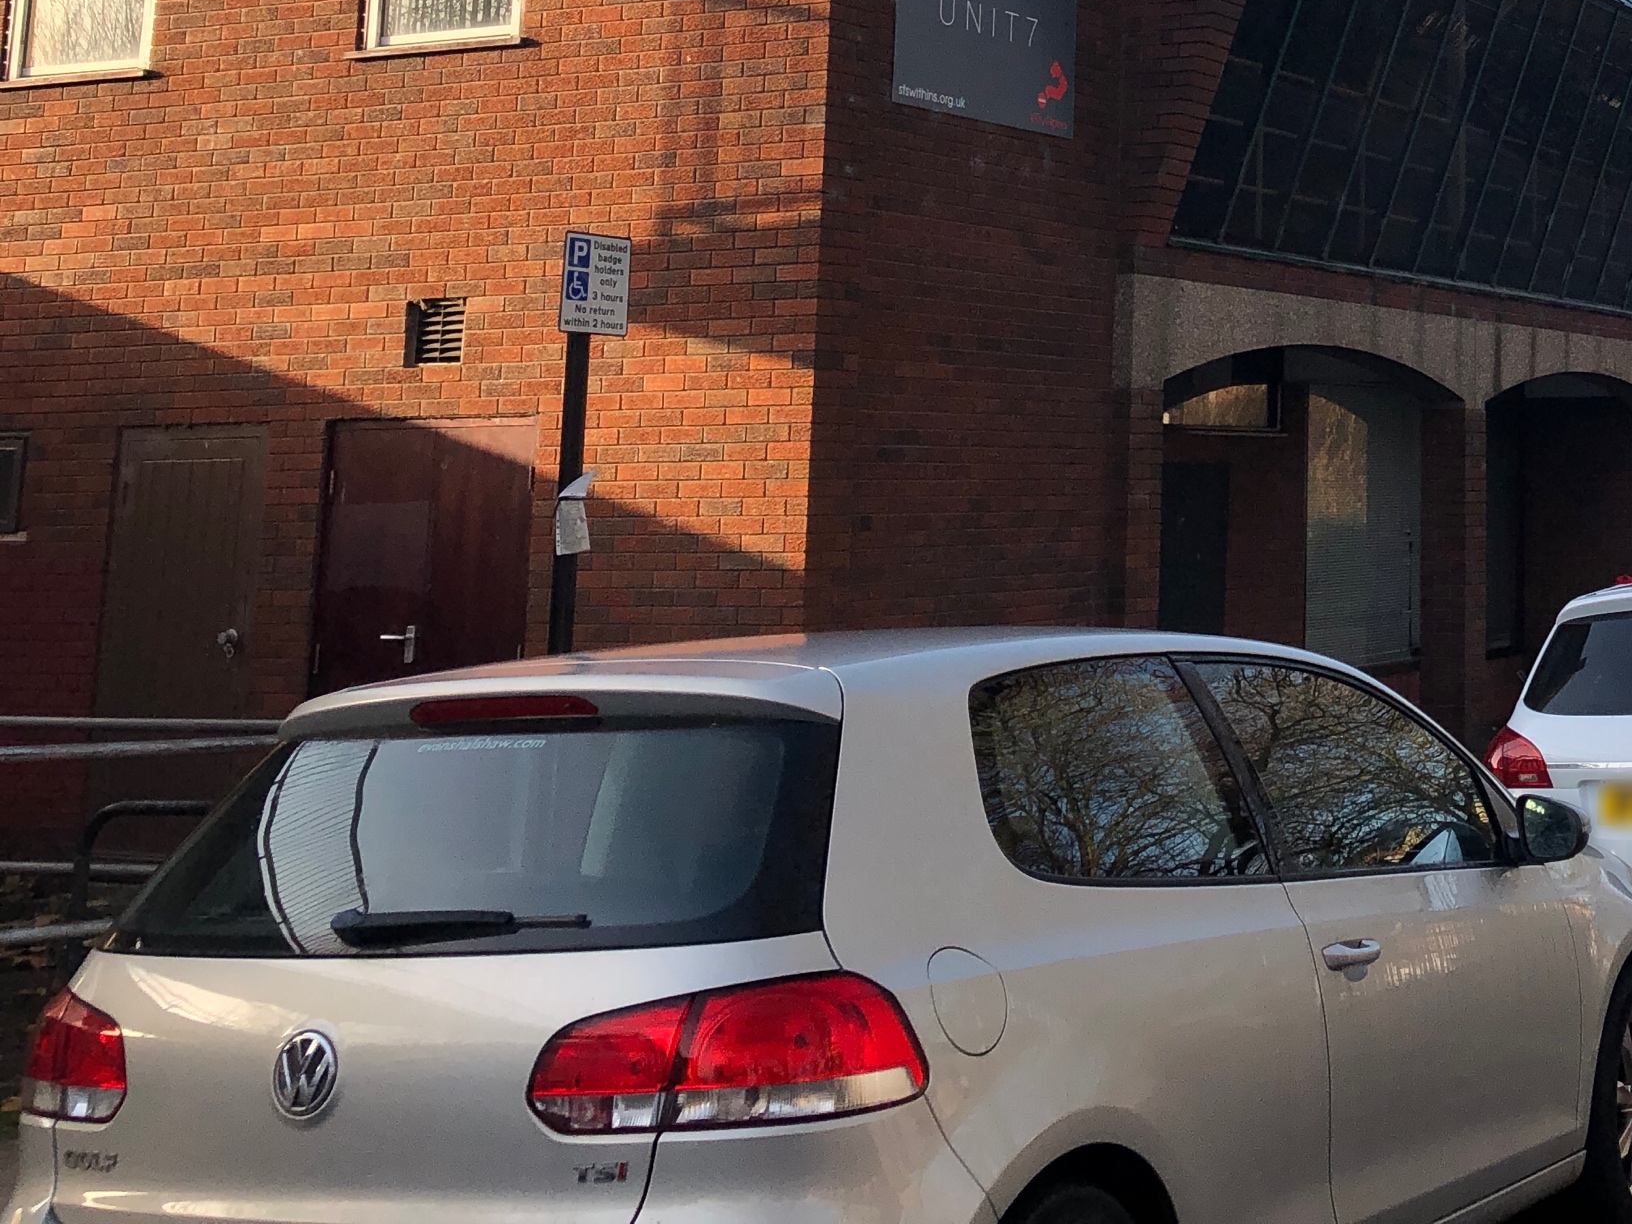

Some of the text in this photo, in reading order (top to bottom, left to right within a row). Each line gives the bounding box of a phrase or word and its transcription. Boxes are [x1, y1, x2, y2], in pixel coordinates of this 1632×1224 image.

[898, 84, 966, 109] stswithins.org.uk
[573, 240, 588, 264] P
[593, 240, 628, 253] Disabled
[597, 253, 622, 265] badge
[594, 265, 624, 276] holders
[599, 278, 617, 288] only
[592, 291, 623, 303] 3 hours
[574, 304, 615, 316] No return
[563, 317, 624, 330] within 2 hours
[418, 737, 546, 753] evanshalshaw.com
[573, 1161, 628, 1183] TSI
